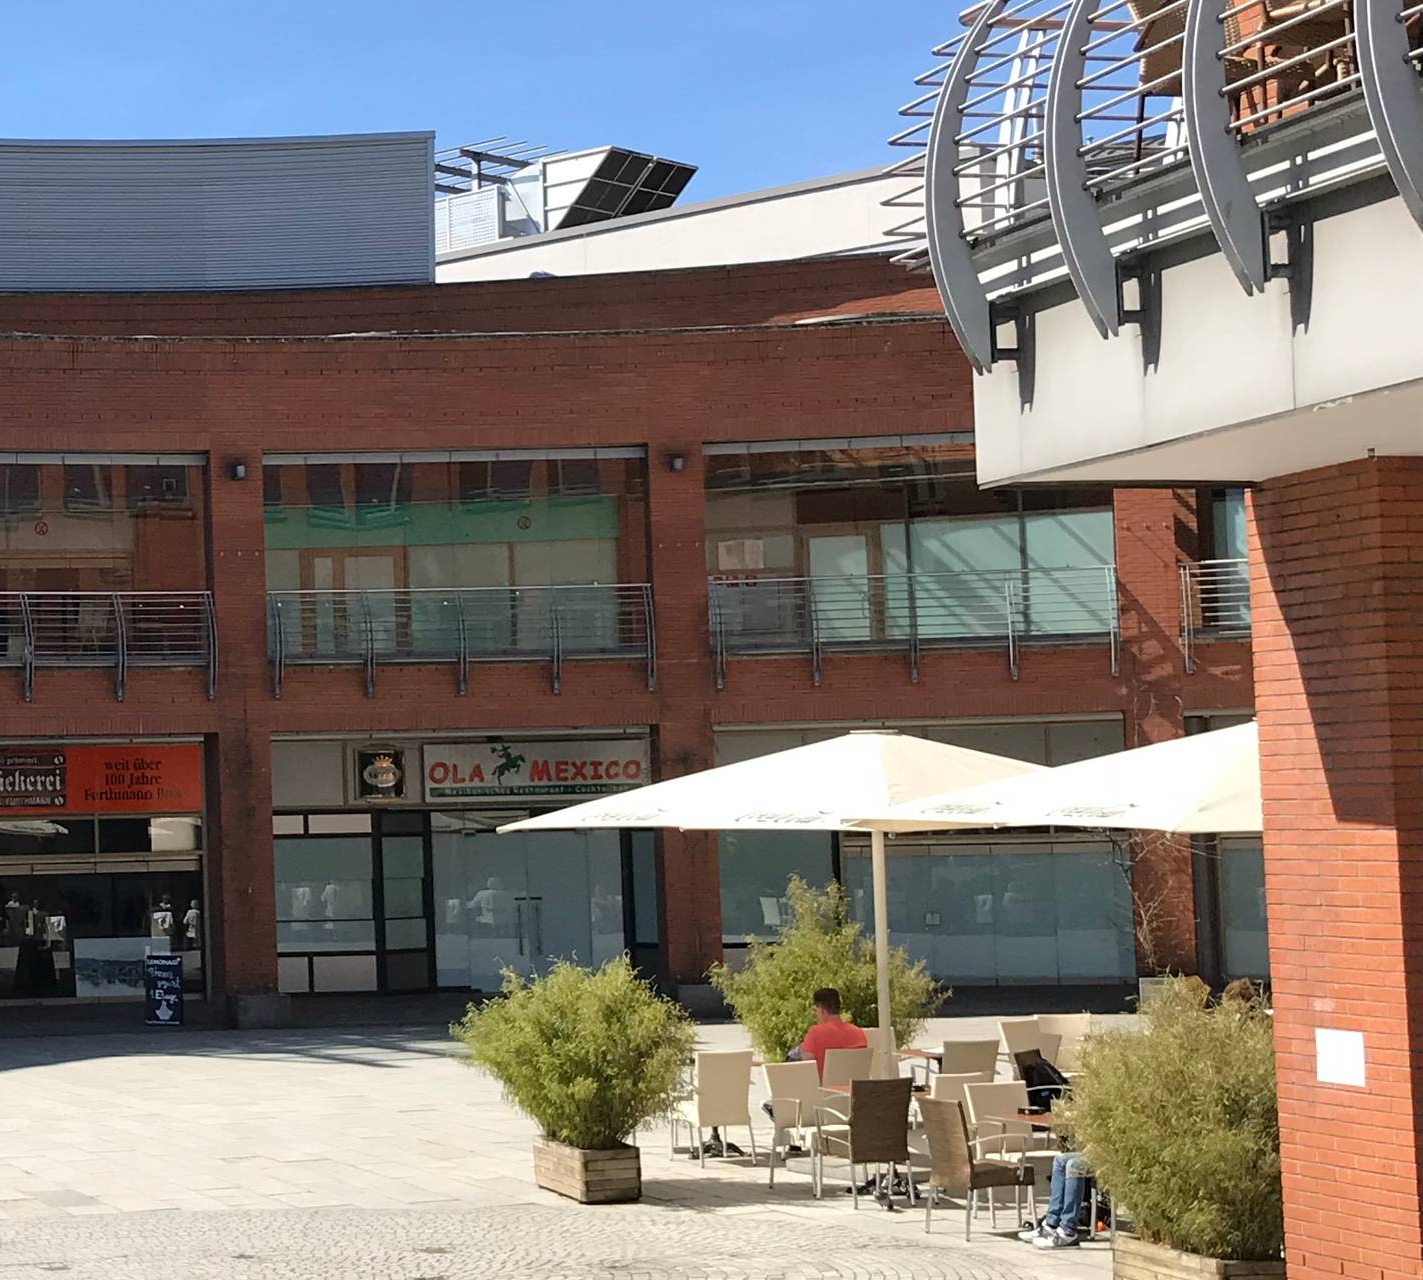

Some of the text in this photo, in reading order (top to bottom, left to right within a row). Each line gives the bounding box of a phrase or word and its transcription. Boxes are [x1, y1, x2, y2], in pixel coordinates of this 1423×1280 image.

[103, 757, 162, 771] weit über
[428, 759, 642, 785] OLA MEXICO
[104, 772, 162, 789] 100 Jahre
[512, 785, 565, 795] Restaurant
